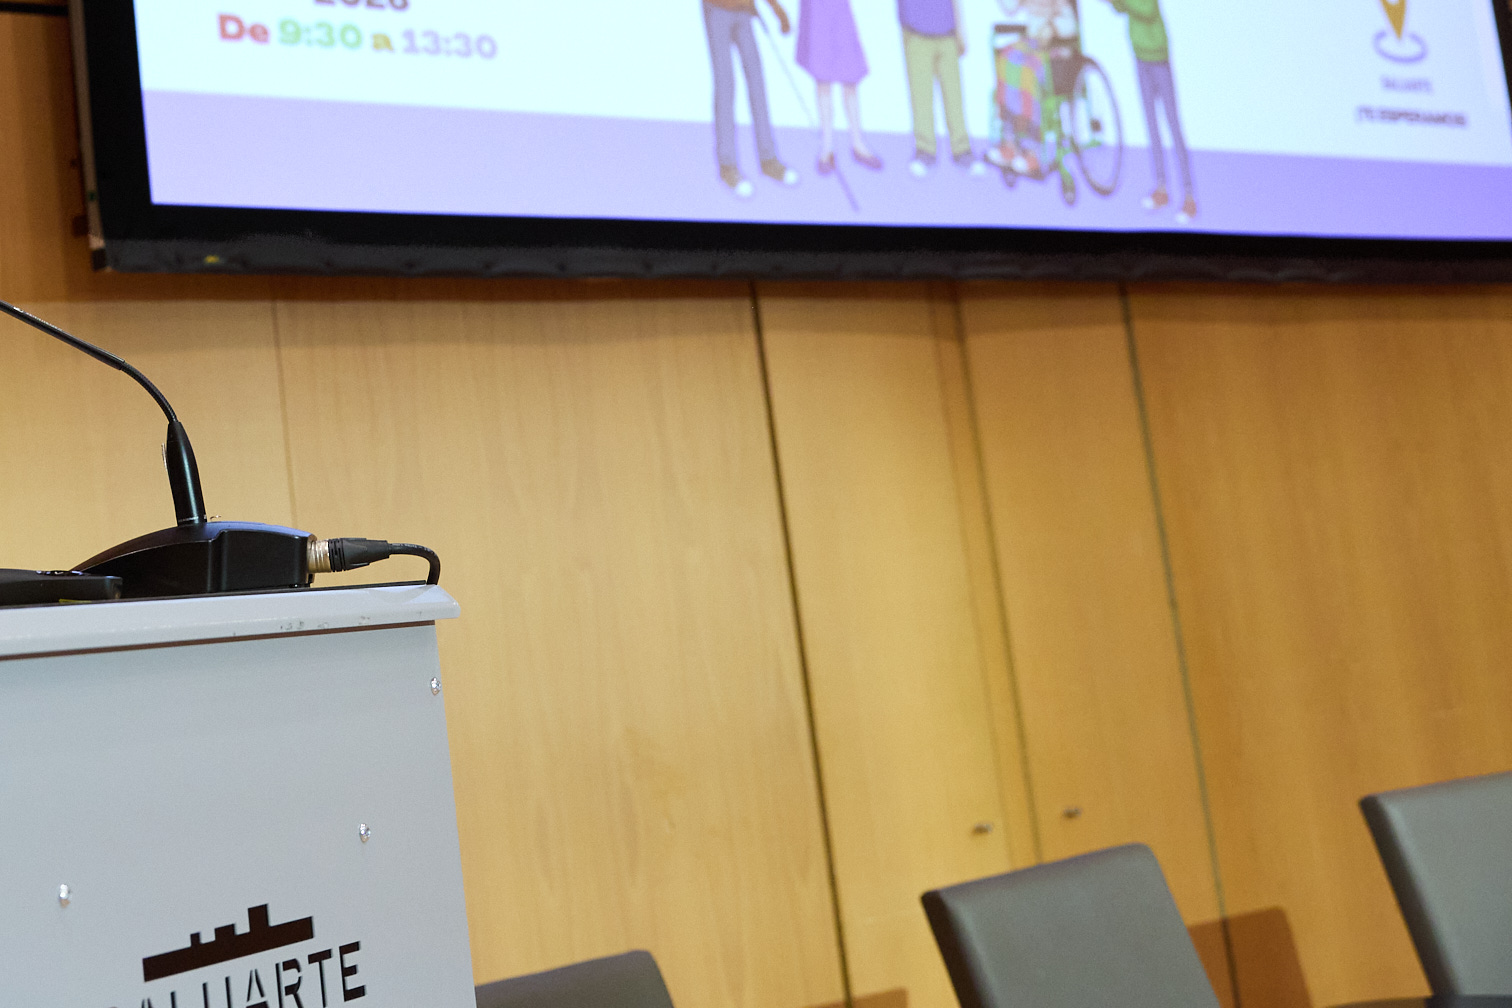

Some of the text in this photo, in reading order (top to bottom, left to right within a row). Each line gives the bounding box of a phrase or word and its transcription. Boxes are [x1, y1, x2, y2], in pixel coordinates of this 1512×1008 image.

[218, 13, 498, 59] De 9:30 a 13:30
[108, 941, 366, 1008] ARTE
